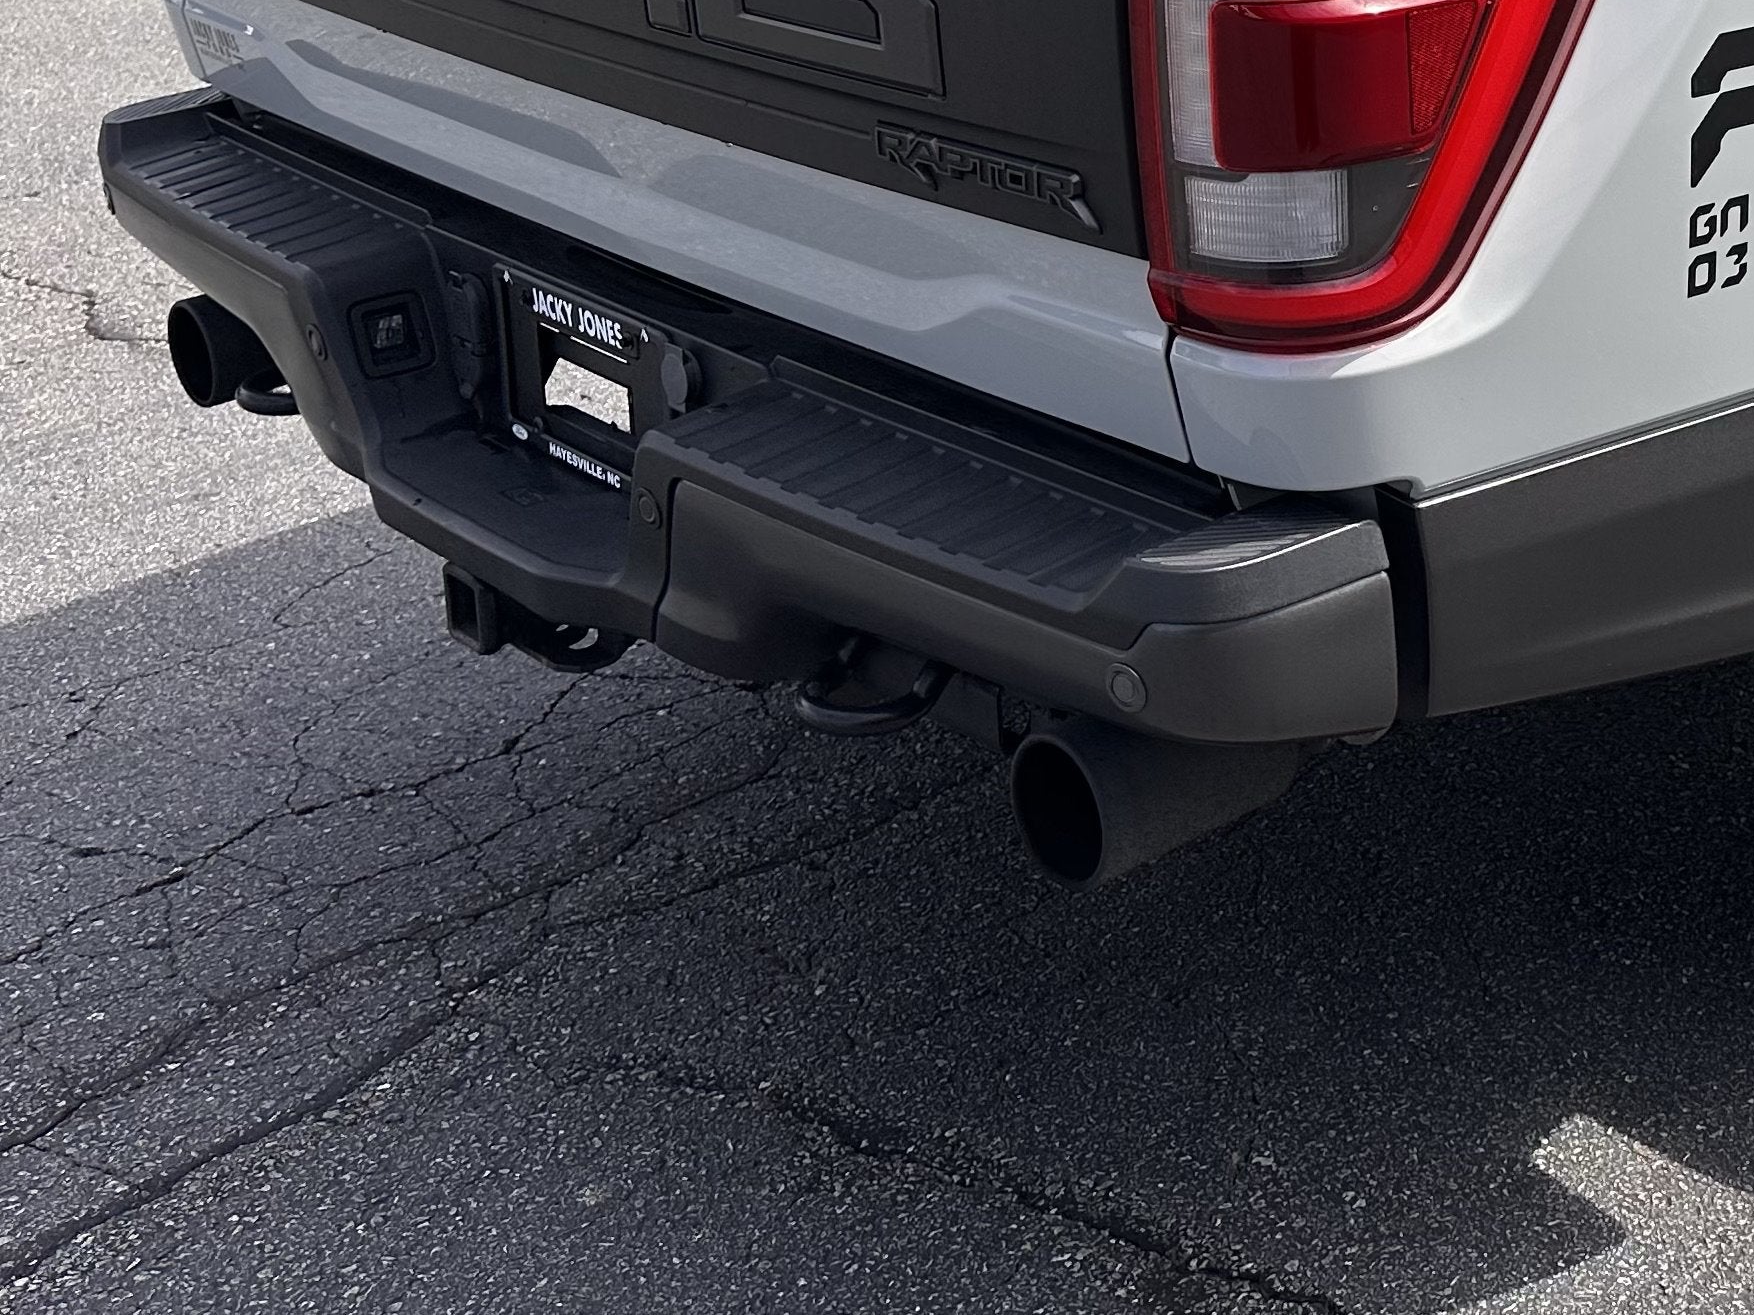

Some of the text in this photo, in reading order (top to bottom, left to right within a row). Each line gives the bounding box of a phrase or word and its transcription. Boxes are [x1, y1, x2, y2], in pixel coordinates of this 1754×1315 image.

[874, 121, 1103, 233] RAPTOR
[532, 287, 623, 351] JACKY JONES
[607, 471, 621, 489] NC
